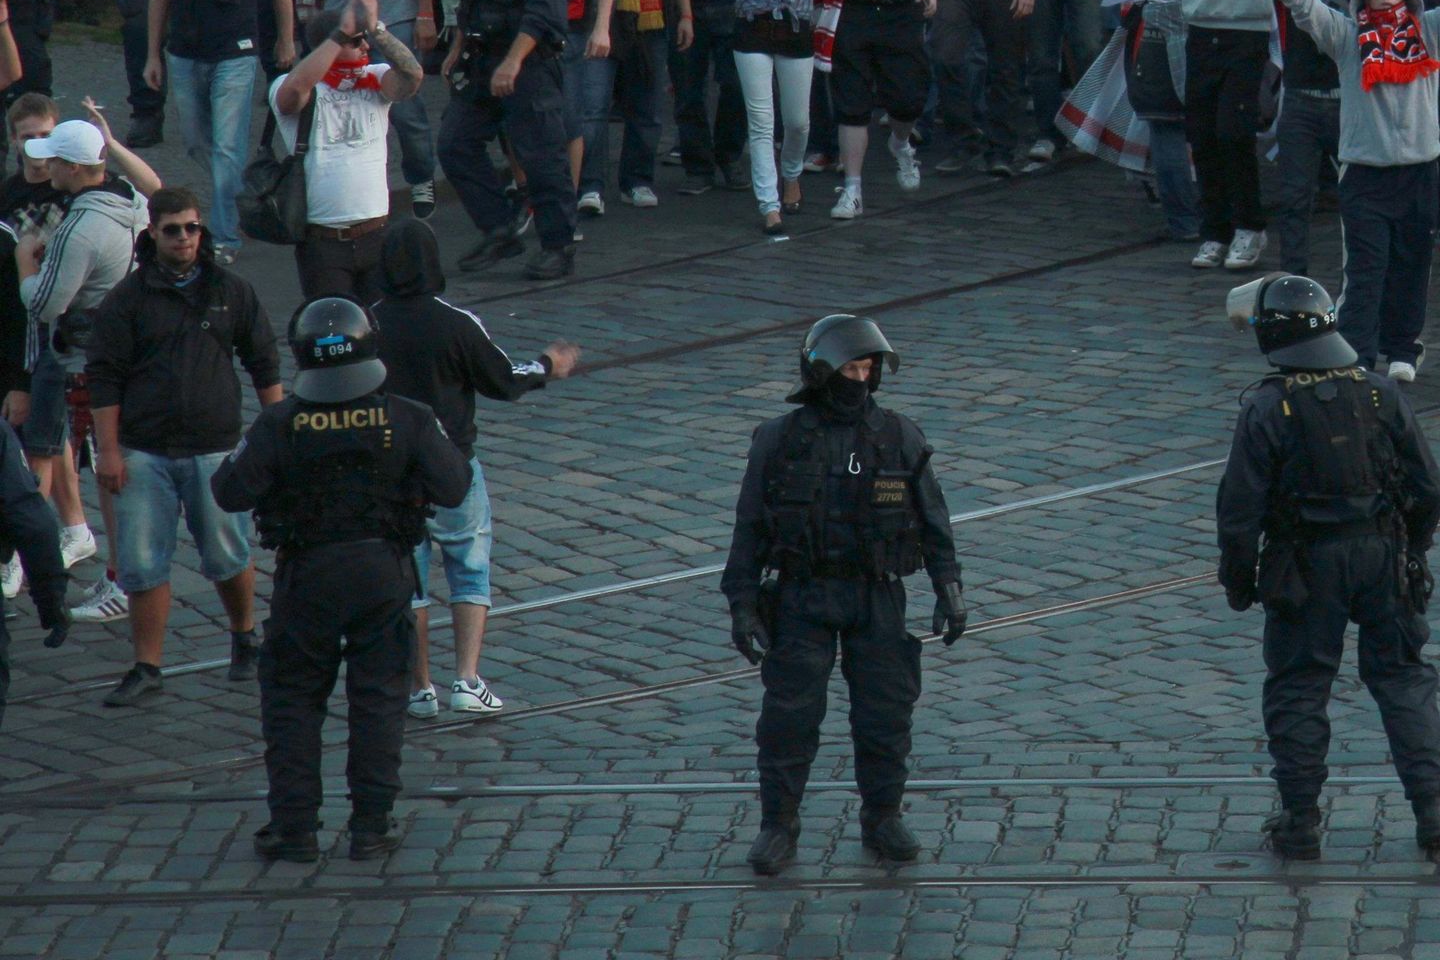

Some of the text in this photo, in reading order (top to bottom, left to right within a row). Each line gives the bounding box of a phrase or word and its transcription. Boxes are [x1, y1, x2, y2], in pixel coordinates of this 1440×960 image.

[1309, 317, 1318, 328] B
[314, 342, 353, 357] B 094
[1285, 367, 1367, 394] POLICIE
